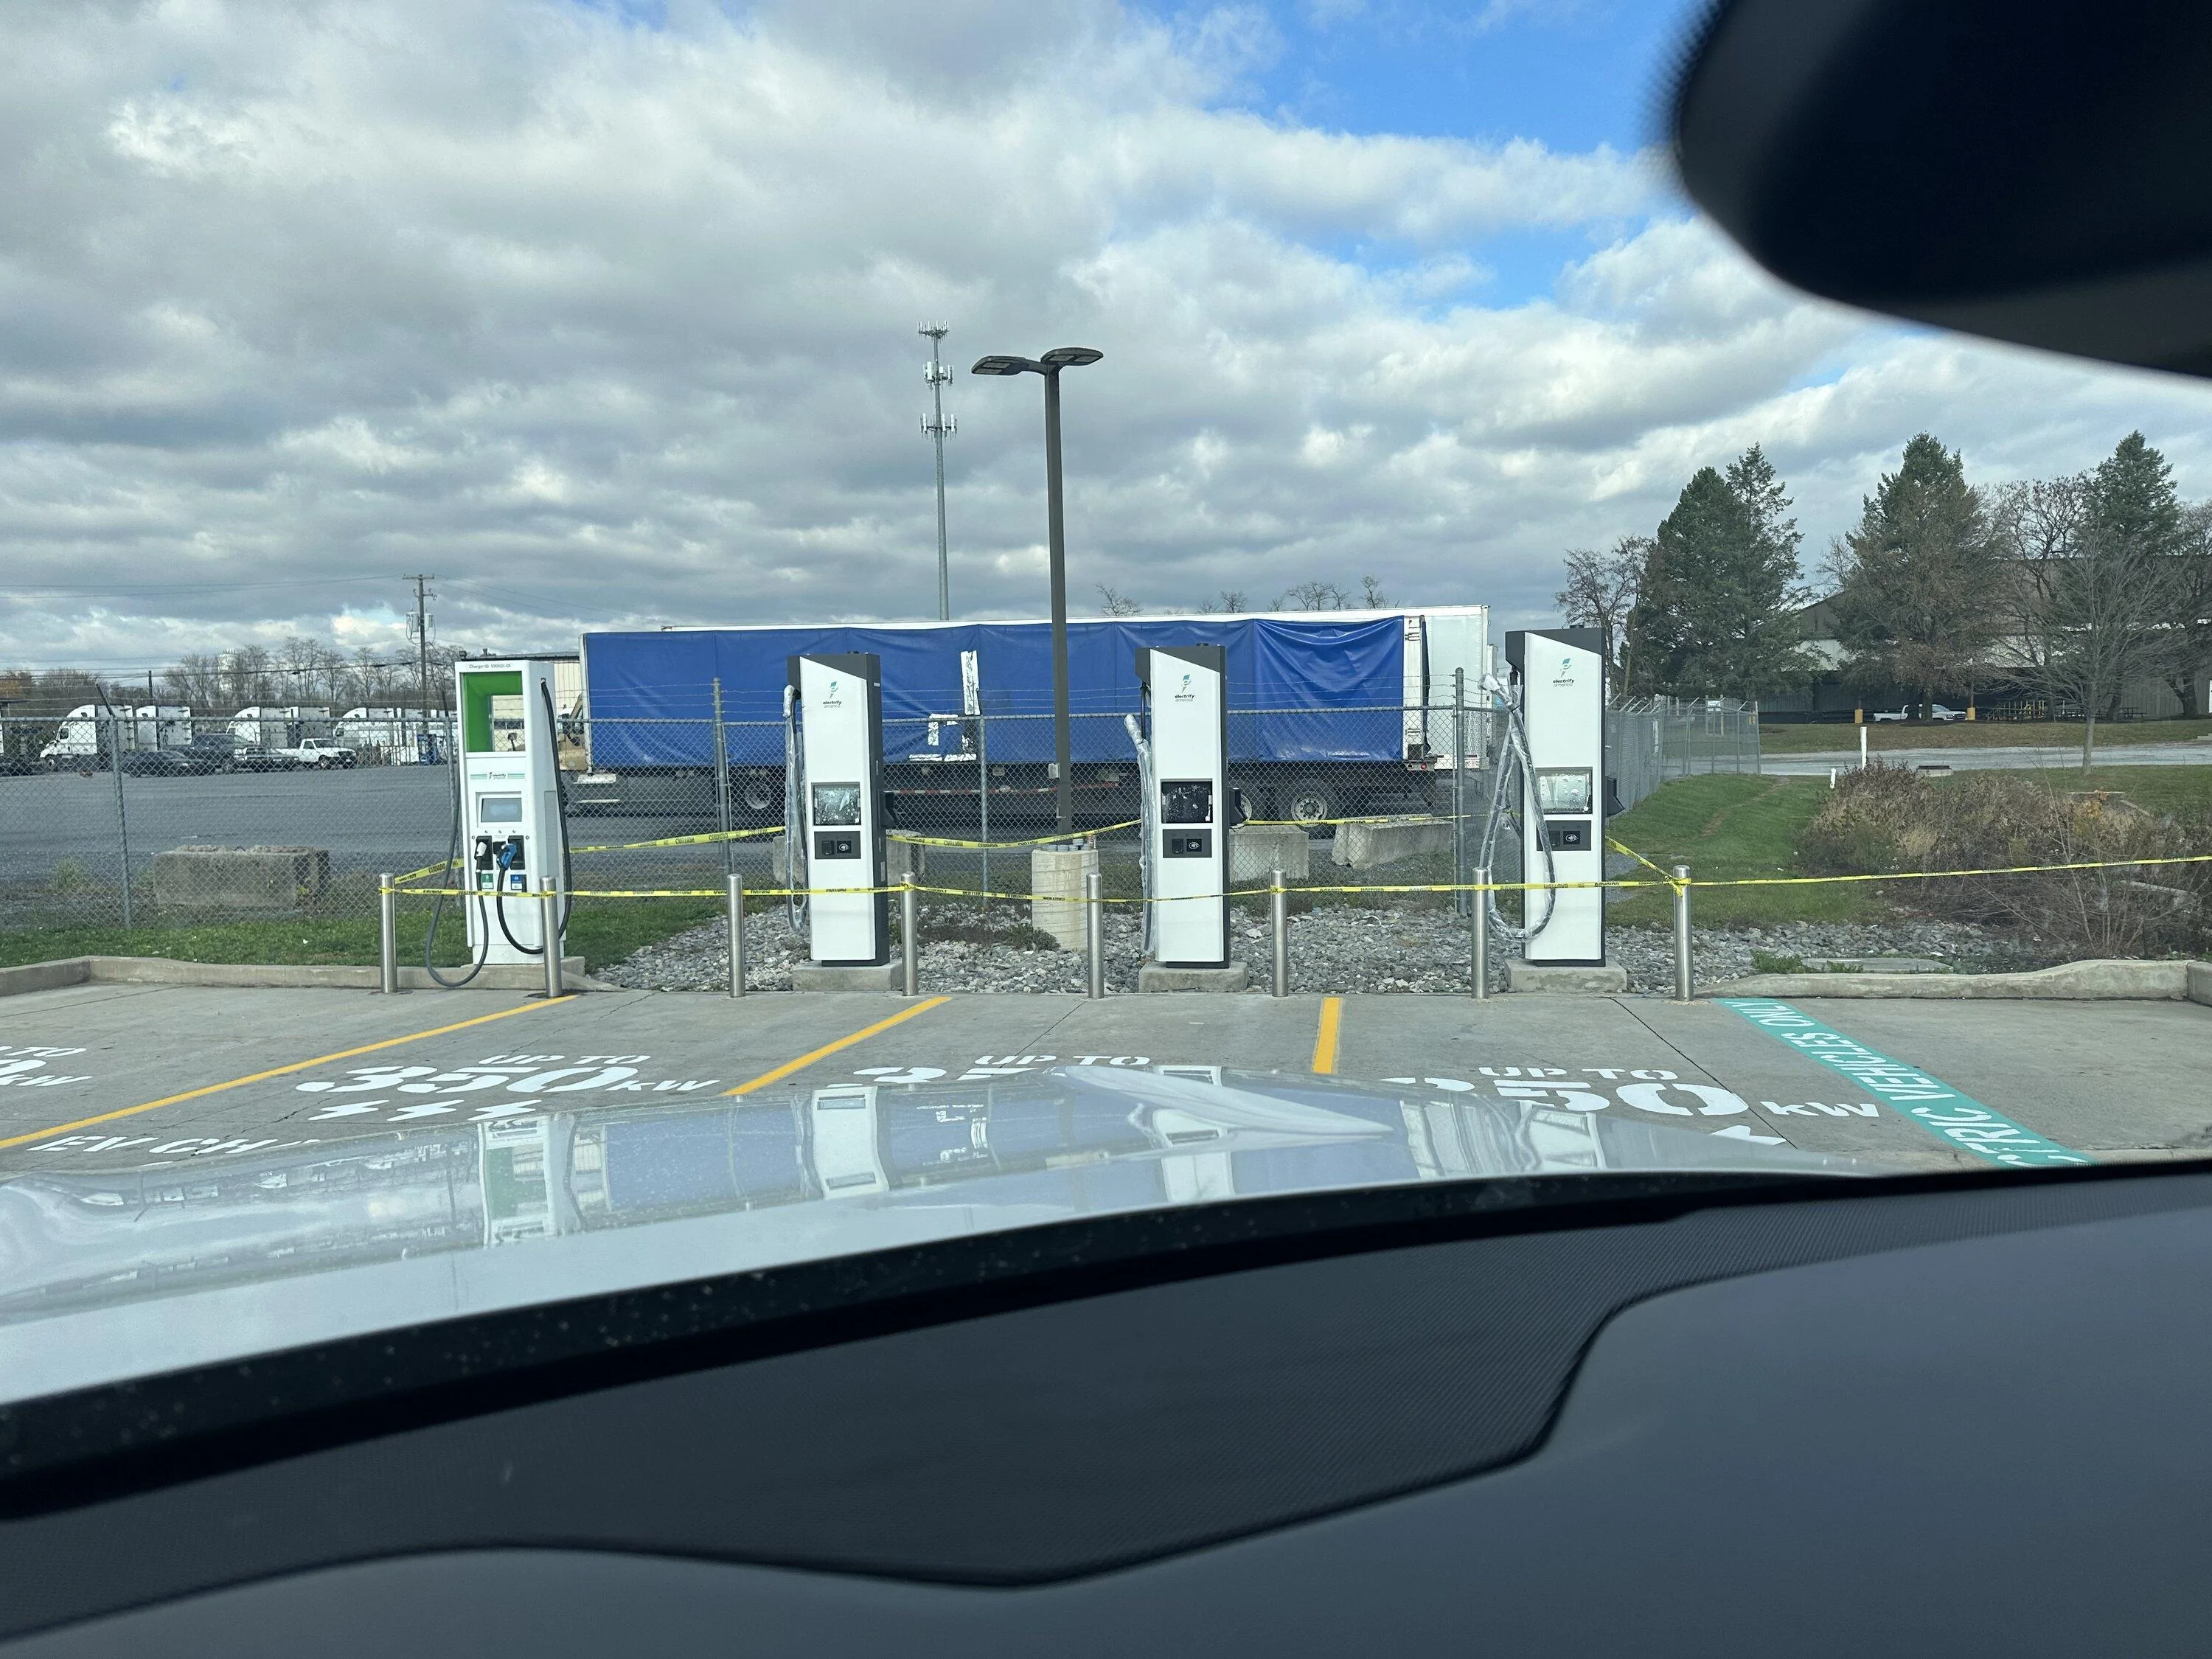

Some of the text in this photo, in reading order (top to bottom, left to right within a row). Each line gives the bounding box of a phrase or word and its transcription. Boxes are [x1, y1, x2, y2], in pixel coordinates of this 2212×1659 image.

[1724, 1001, 1816, 1028] ONLY
[478, 1054, 652, 1065] UP TO
[974, 1055, 1150, 1066] UP TO
[1781, 1032, 1956, 1101] VEHICLES
[295, 1065, 639, 1093] 350
[1478, 1066, 1679, 1080] UP TO
[27, 1135, 159, 1152] EV
